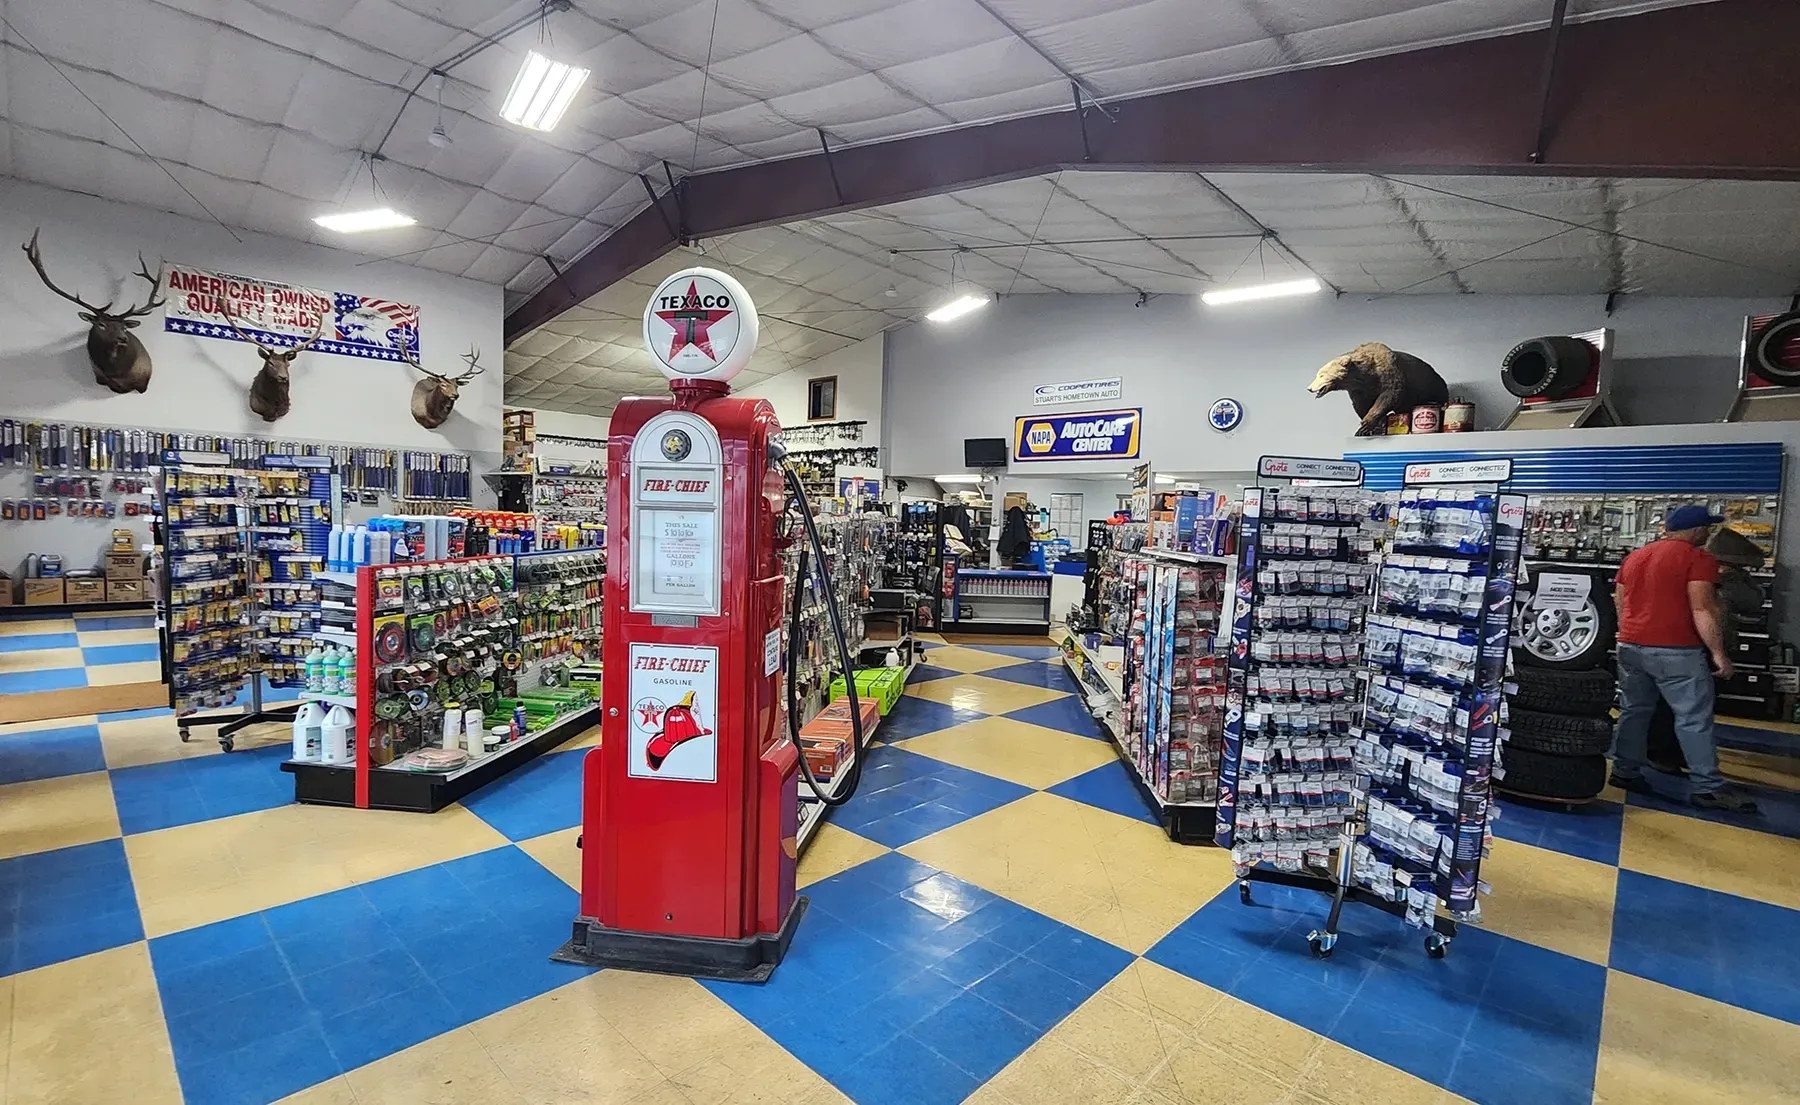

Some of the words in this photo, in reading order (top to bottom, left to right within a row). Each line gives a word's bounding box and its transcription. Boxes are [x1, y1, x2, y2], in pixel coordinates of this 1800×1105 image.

[217, 272, 259, 284] COOPER
[169, 271, 264, 303] AMERICAN
[272, 289, 331, 313] OWNED
[660, 295, 730, 309] TEXACO
[187, 293, 265, 323] QUALITY
[273, 307, 320, 328] MADE
[1063, 391, 1100, 401] HOMETOWN
[1100, 389, 1119, 398] AUTO
[1031, 431, 1051, 445] NAPA
[1072, 437, 1113, 452] CENTER
[1264, 459, 1288, 476] Grote
[1409, 466, 1431, 483] Grote
[643, 479, 710, 493] FIRE-CHIEF
[1500, 503, 1524, 518] Grote
[634, 656, 711, 674] FIRE-CHIEF
[653, 677, 693, 686] GASOLINE
[639, 703, 665, 711] TEXACO
